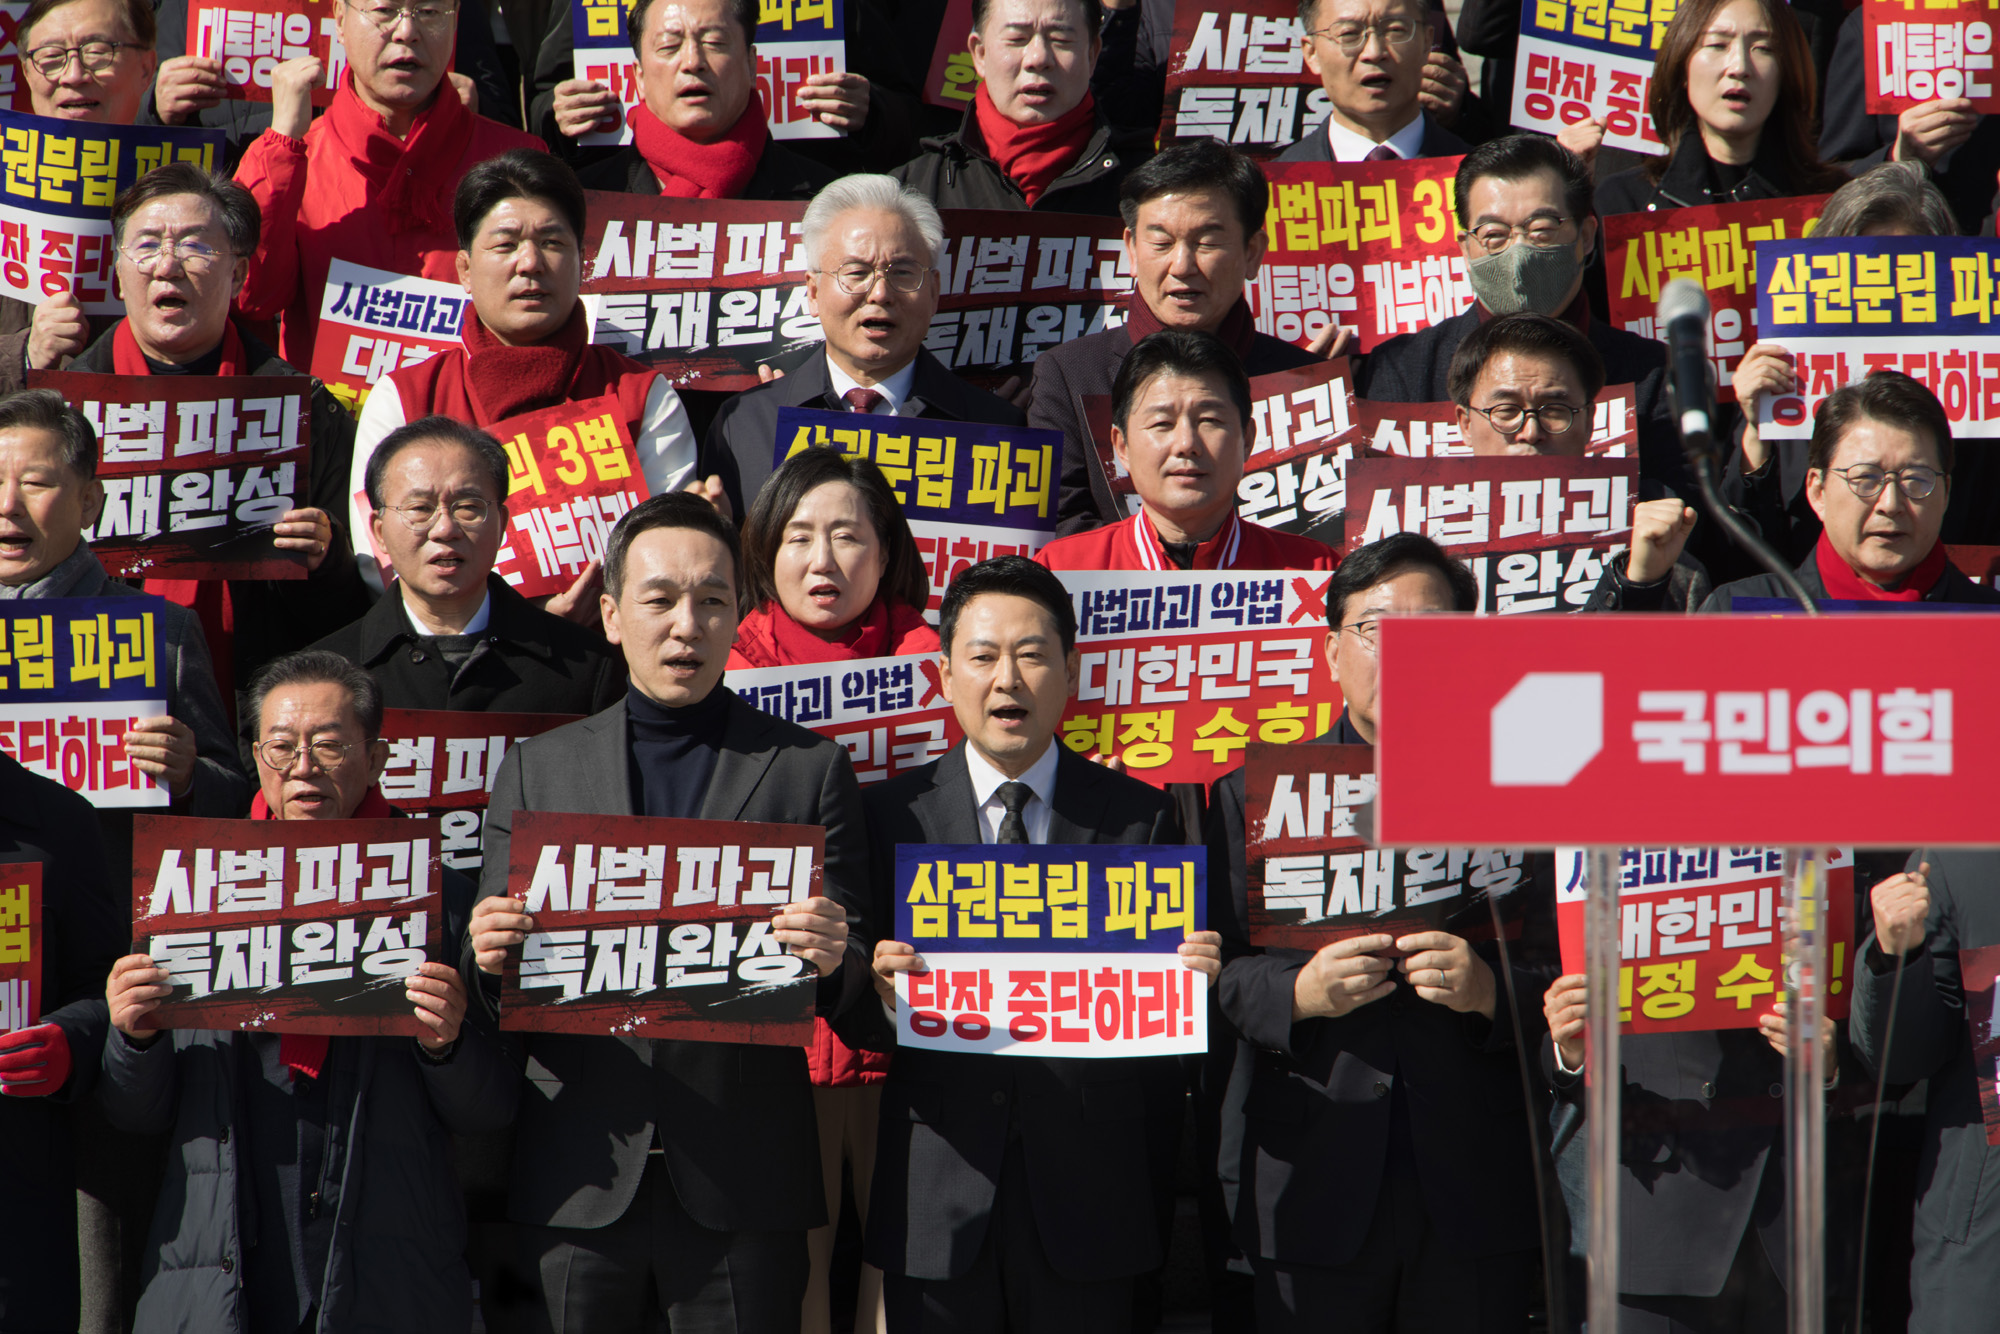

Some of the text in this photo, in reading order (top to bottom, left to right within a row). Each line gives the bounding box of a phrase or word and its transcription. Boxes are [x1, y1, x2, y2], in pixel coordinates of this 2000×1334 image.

[1182, 12, 1303, 74] 사법
[1877, 22, 1993, 100] 대통령은
[1175, 87, 1301, 144] 독재
[1525, 53, 1597, 126] 당장
[0, 124, 121, 207] 권분립
[39, 229, 123, 302] 중단
[591, 220, 718, 279] 사법
[330, 281, 472, 336] 사법파괴
[592, 291, 712, 352] 독재
[1244, 263, 1360, 343] 대통령은
[1767, 251, 2000, 325] 삼권분립 파
[174, 394, 301, 457] 파괴
[546, 413, 632, 485] 3법
[1250, 376, 1350, 457] 파괴
[82, 461, 297, 543] 재 완성
[967, 440, 1053, 518] 파괴
[1362, 475, 1629, 547] 사법 파괴
[511, 491, 641, 578] 거부하
[1210, 578, 1285, 626] 악법
[0, 612, 156, 690] 립 파괴
[1077, 638, 1314, 706] 대한민국
[841, 663, 914, 714] 악법
[0, 716, 157, 792] 단하라
[442, 735, 529, 795] 파
[1631, 687, 1954, 776] 국민의힘
[148, 838, 431, 915] 사법 파괴
[523, 844, 814, 912] 사법 파괴
[906, 860, 1195, 940] 삼권분립 파괴
[1262, 849, 1396, 921] 독재
[149, 910, 428, 999] 독재 완성
[1617, 880, 1829, 961] 대한민
[518, 921, 804, 999] 독재 완성
[1617, 959, 1697, 1023] 정
[907, 966, 1194, 1043] 당장 중단하라!
